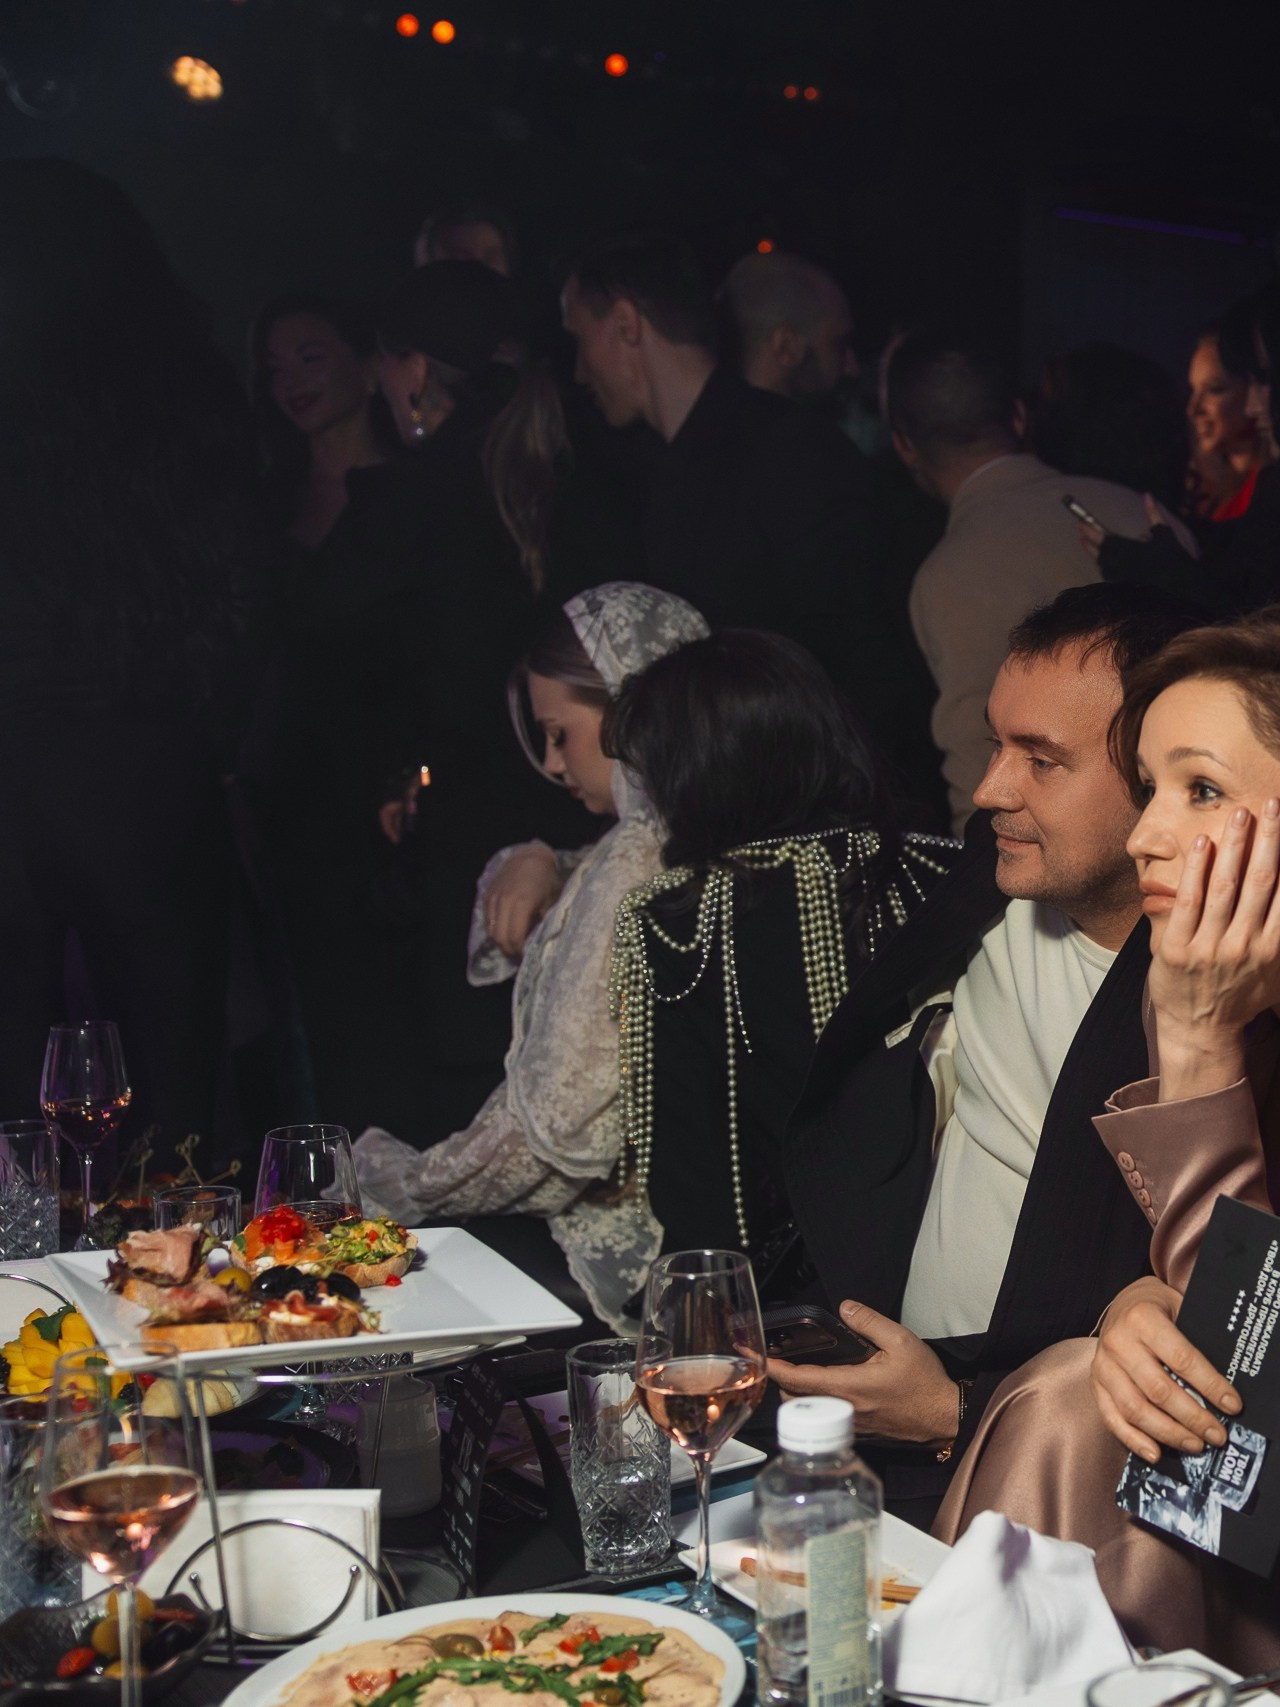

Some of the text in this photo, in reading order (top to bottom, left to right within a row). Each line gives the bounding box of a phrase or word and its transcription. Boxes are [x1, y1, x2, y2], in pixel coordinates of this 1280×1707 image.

[1254, 1271, 1269, 1297] ДОМ
[1226, 1302, 1258, 1385] ДРАГОЦЕННОСТ
[1239, 1269, 1280, 1373] В КЛУБ ПРИВИЛЕГИЙ
[1249, 1310, 1279, 1377] ПОЖАЛОВАТЬ
[1218, 1444, 1240, 1482] ДОМ
